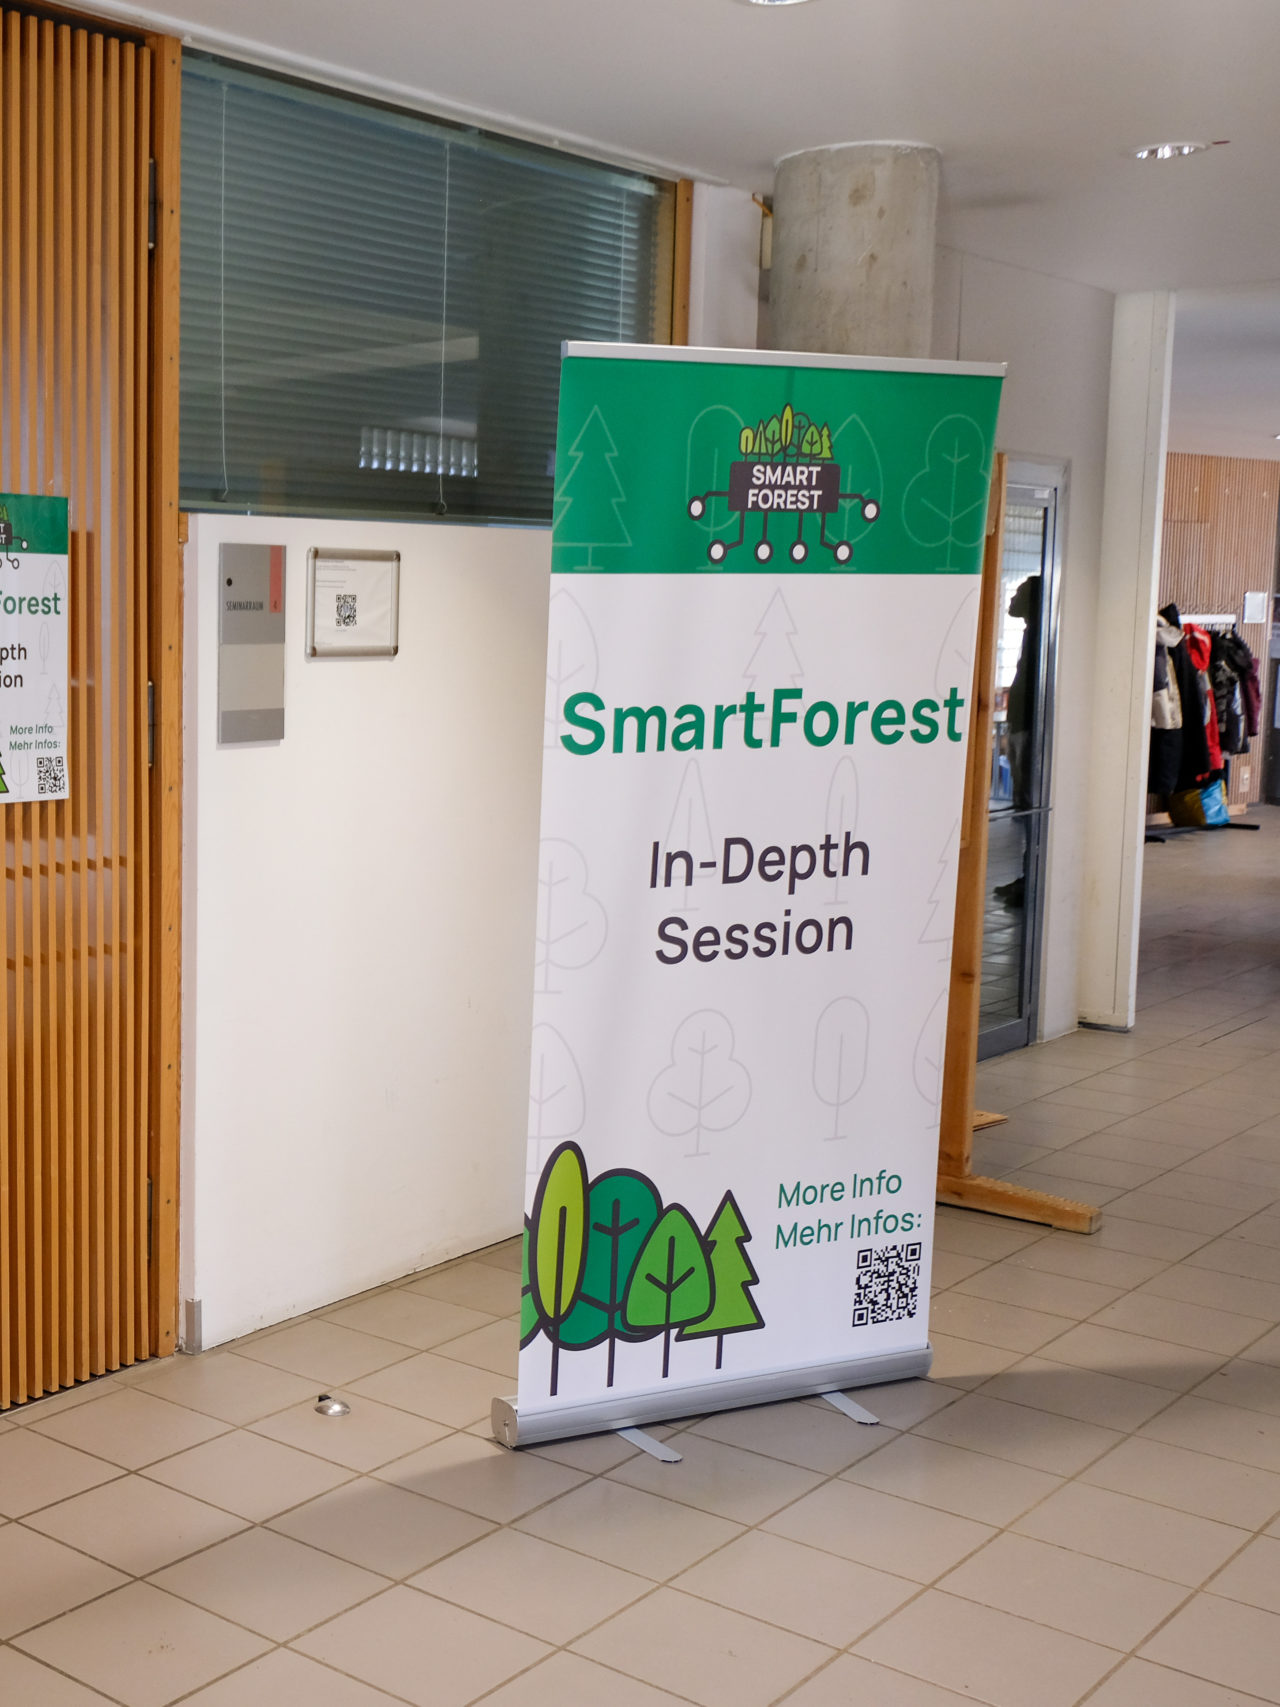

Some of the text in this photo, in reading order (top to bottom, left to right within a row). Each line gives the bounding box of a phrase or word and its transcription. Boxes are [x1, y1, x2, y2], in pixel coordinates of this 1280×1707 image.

[751, 465, 821, 486] SMART
[747, 490, 822, 510] FOREST
[10, 723, 54, 735] More Info
[560, 686, 965, 756] SmartForest
[9, 739, 61, 751] Mehr Infos:
[649, 831, 871, 895] In-Depth
[655, 909, 854, 965] Session
[777, 1170, 902, 1209] More Info
[775, 1208, 922, 1250] Mehr Infos:
